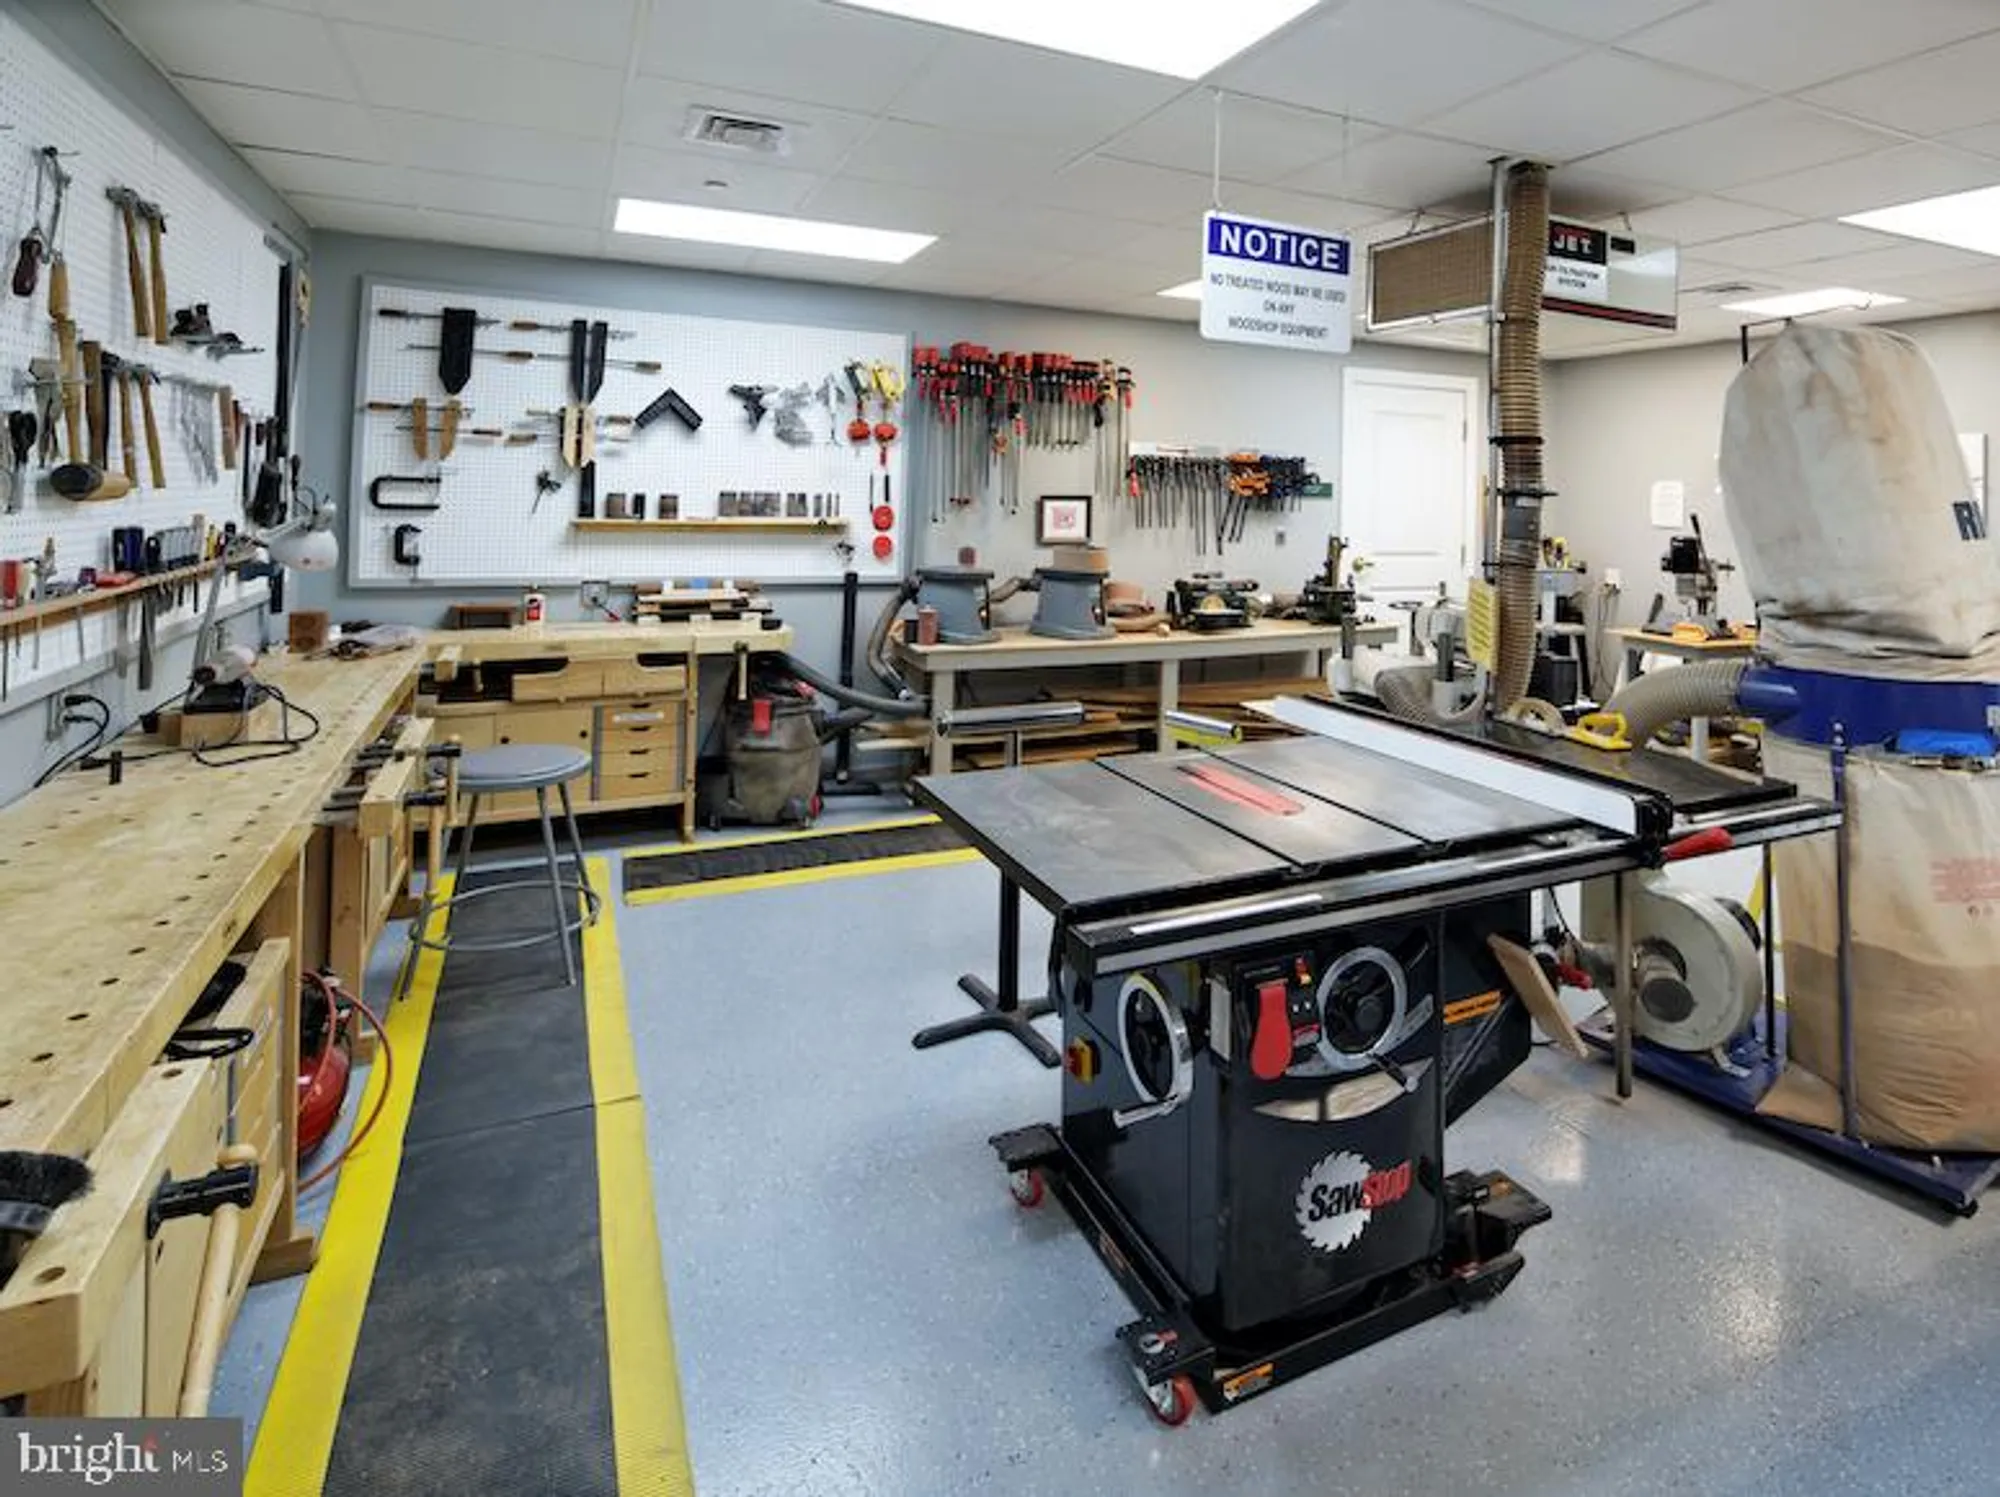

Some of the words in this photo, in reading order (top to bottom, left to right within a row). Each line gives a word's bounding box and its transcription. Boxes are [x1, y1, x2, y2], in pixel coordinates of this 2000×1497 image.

[1220, 224, 1340, 270] NOTICE
[1553, 234, 1593, 254] JET
[1210, 272, 1224, 287] NO
[1226, 274, 1264, 291] TREATED
[1266, 280, 1292, 296] WOOD
[1293, 284, 1310, 298] MAY
[1311, 287, 1323, 300] BE
[1325, 288, 1346, 304] USED
[1262, 299, 1277, 313] ON
[1278, 302, 1295, 315] ANY
[1228, 316, 1278, 333] WOODSHOP
[1280, 322, 1329, 339] EQUIPMENT
